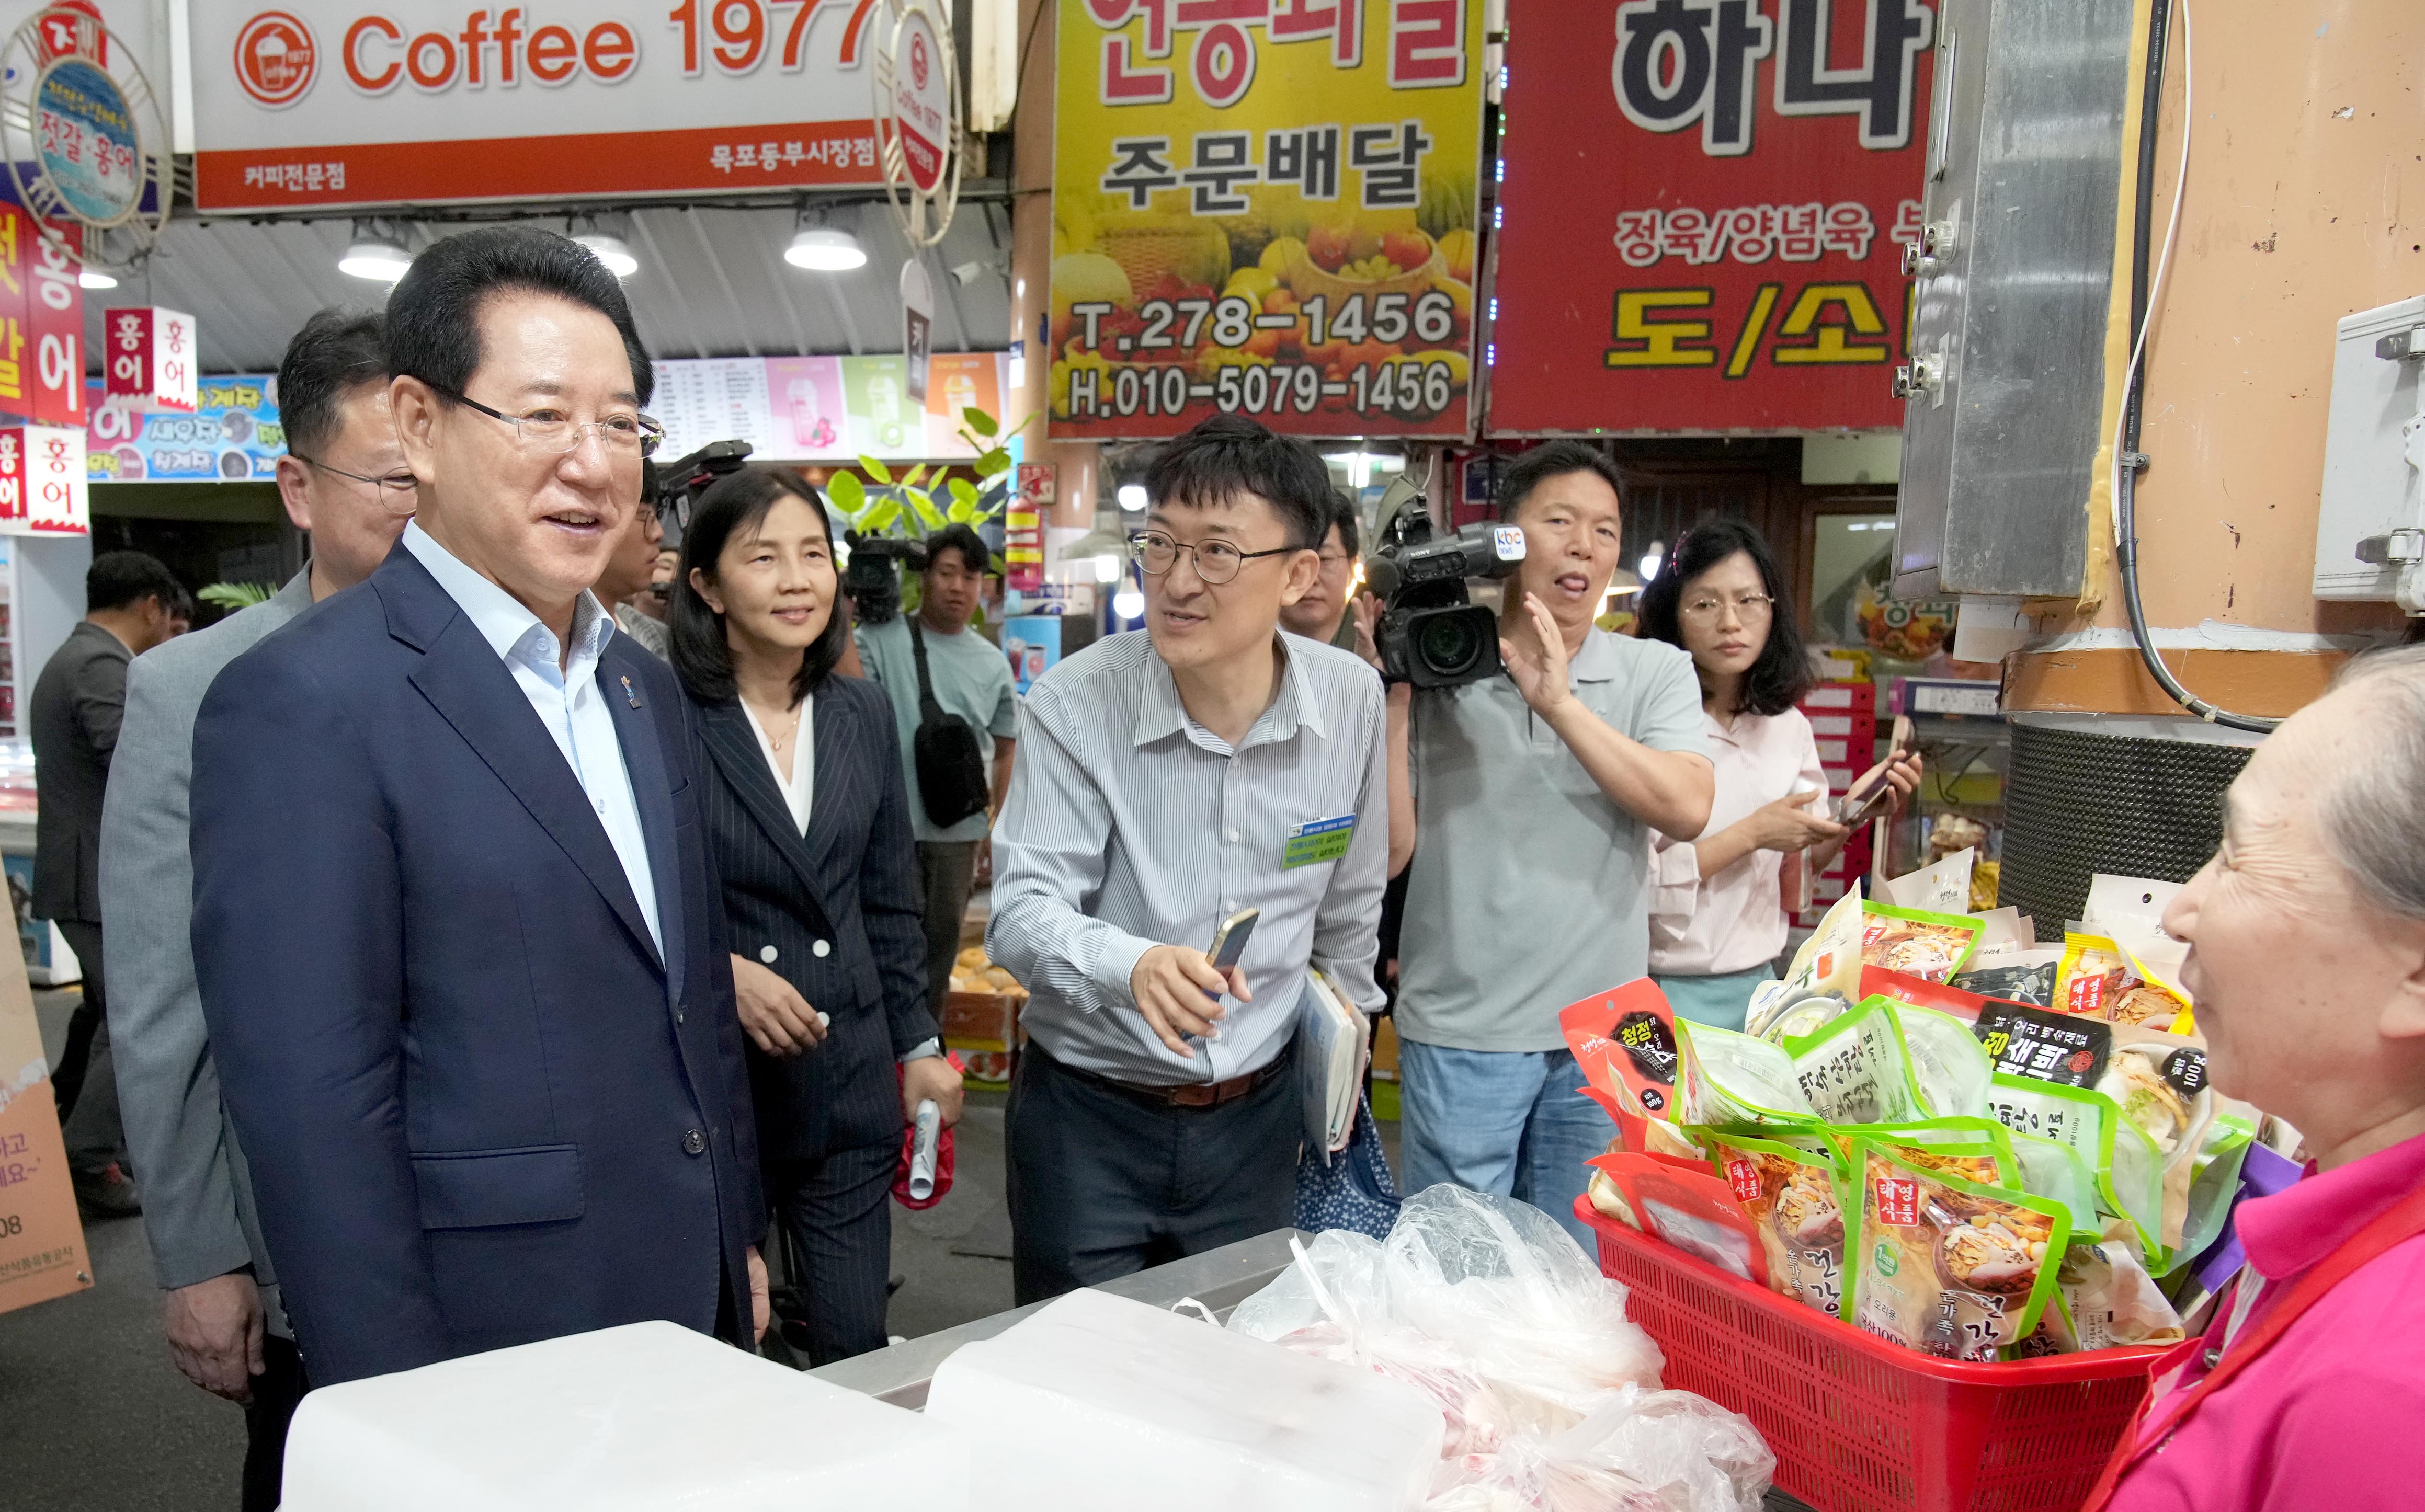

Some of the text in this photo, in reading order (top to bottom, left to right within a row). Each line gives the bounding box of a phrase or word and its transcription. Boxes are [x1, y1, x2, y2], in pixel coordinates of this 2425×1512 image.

[343, 0, 876, 90] Coffee 1977
[710, 137, 875, 173] 목포동부시장점
[1104, 123, 1429, 212] 주문배달
[245, 162, 345, 191] 커피전문점
[1616, 203, 1874, 267] 정육/양념육
[1072, 292, 1453, 351] T.278-1456
[1607, 283, 1915, 378] 도/소
[114, 313, 145, 390] 홍어
[164, 318, 187, 393] 홍어
[1070, 361, 1451, 417] H.010-5079-1456
[90, 405, 132, 440] 어
[42, 437, 74, 516] 홍어
[1410, 549, 1430, 557] SONY
[1496, 530, 1521, 545] kbc
[1621, 1020, 1653, 1046] 청정
[2183, 1055, 2207, 1088] 100g
[1646, 1095, 1663, 1109] 100g
[2068, 1117, 2080, 1149] 용량100g
[1732, 1162, 1755, 1179] 태영
[1735, 1179, 1758, 1198] 식품
[1879, 1180, 1915, 1202] 태영
[1880, 1201, 1915, 1223] 식품
[1874, 1300, 1896, 1321] 오리용
[1936, 1289, 1958, 1336] 온가족
